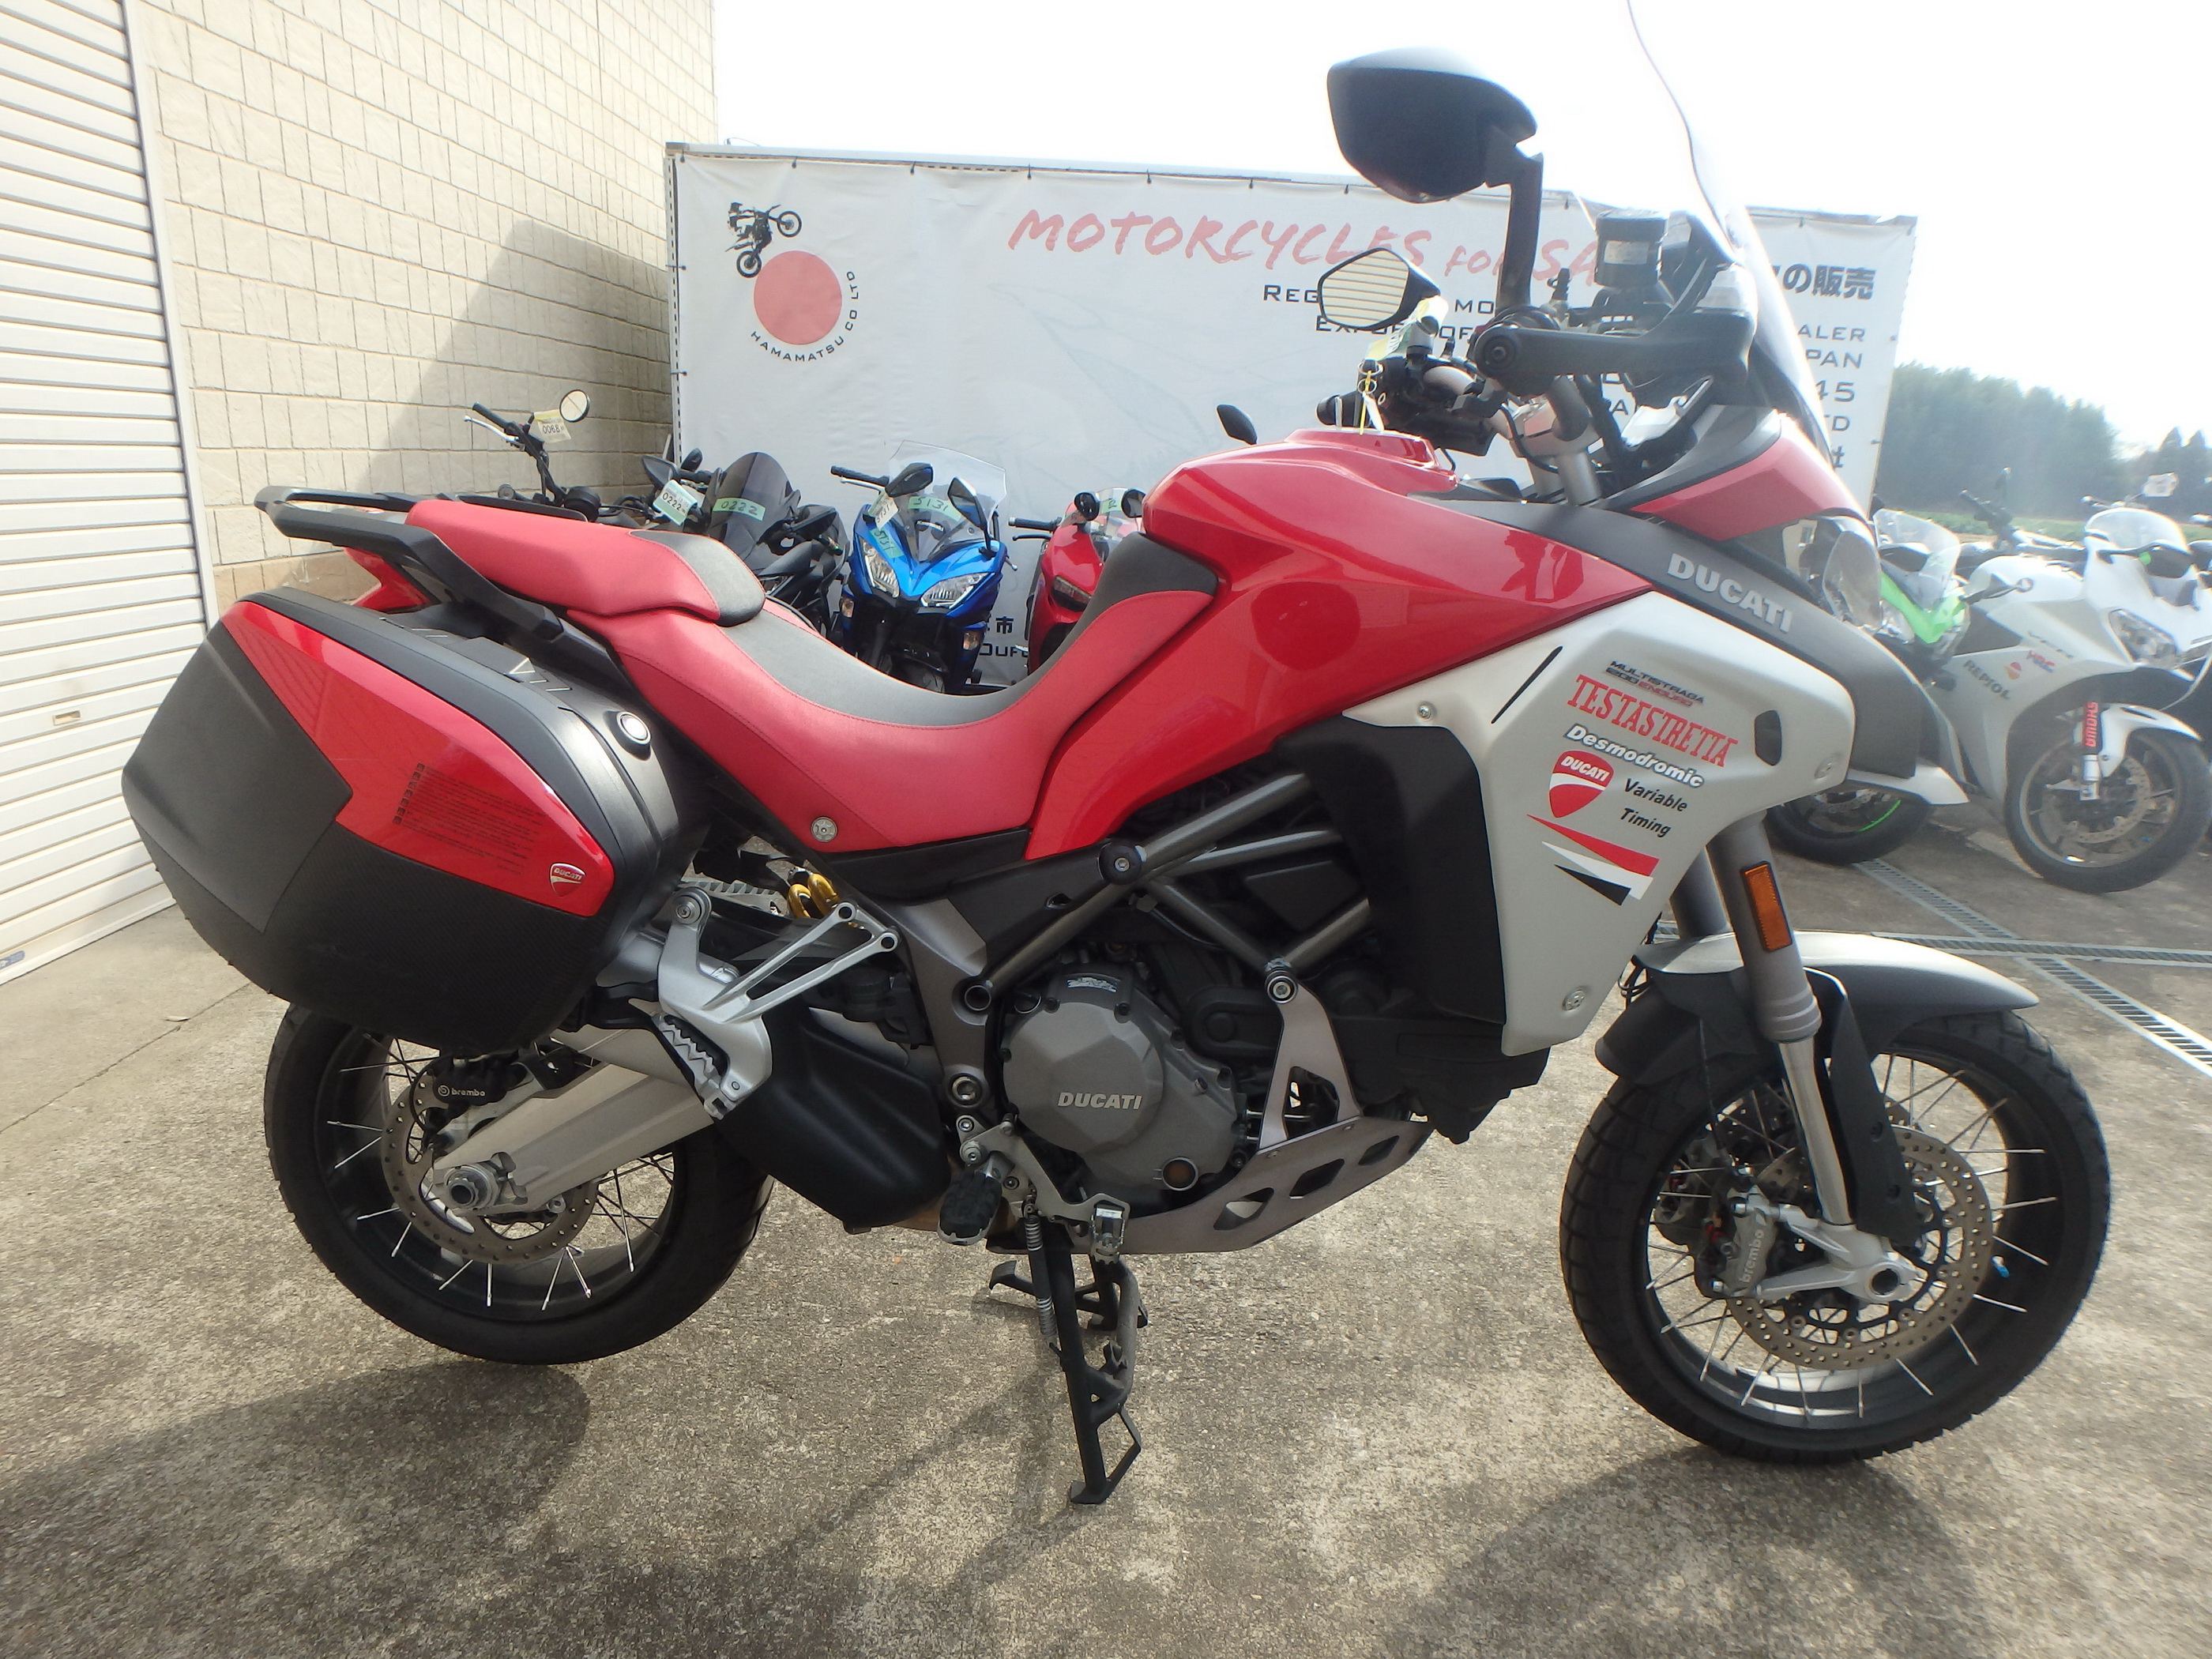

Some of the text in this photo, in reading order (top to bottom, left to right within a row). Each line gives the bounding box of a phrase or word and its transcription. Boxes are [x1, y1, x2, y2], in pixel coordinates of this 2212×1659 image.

[1008, 209, 1431, 269] MOTORCYCLES
[1772, 263, 1877, 300] の販売
[750, 271, 859, 363] HAMAMATSU CO LTD
[662, 492, 682, 512] 0222
[720, 500, 758, 516] 0222
[913, 498, 949, 512] 5131
[1668, 553, 1793, 634] DUCATI
[1610, 660, 1705, 704] MULTISTRADA
[1963, 660, 2011, 701] REPSOL
[1567, 674, 1739, 769] TESTASTRETTA
[1560, 755, 1610, 783] DUCATI
[1564, 723, 1705, 789] Desmodromic
[1623, 778, 1688, 813] Variable
[1619, 808, 1672, 838] Timing
[554, 867, 582, 881] DUCATI
[451, 1087, 486, 1097] brembo
[1057, 1092, 1143, 1111] DUCATI
[1740, 1229, 1764, 1282] brembo
